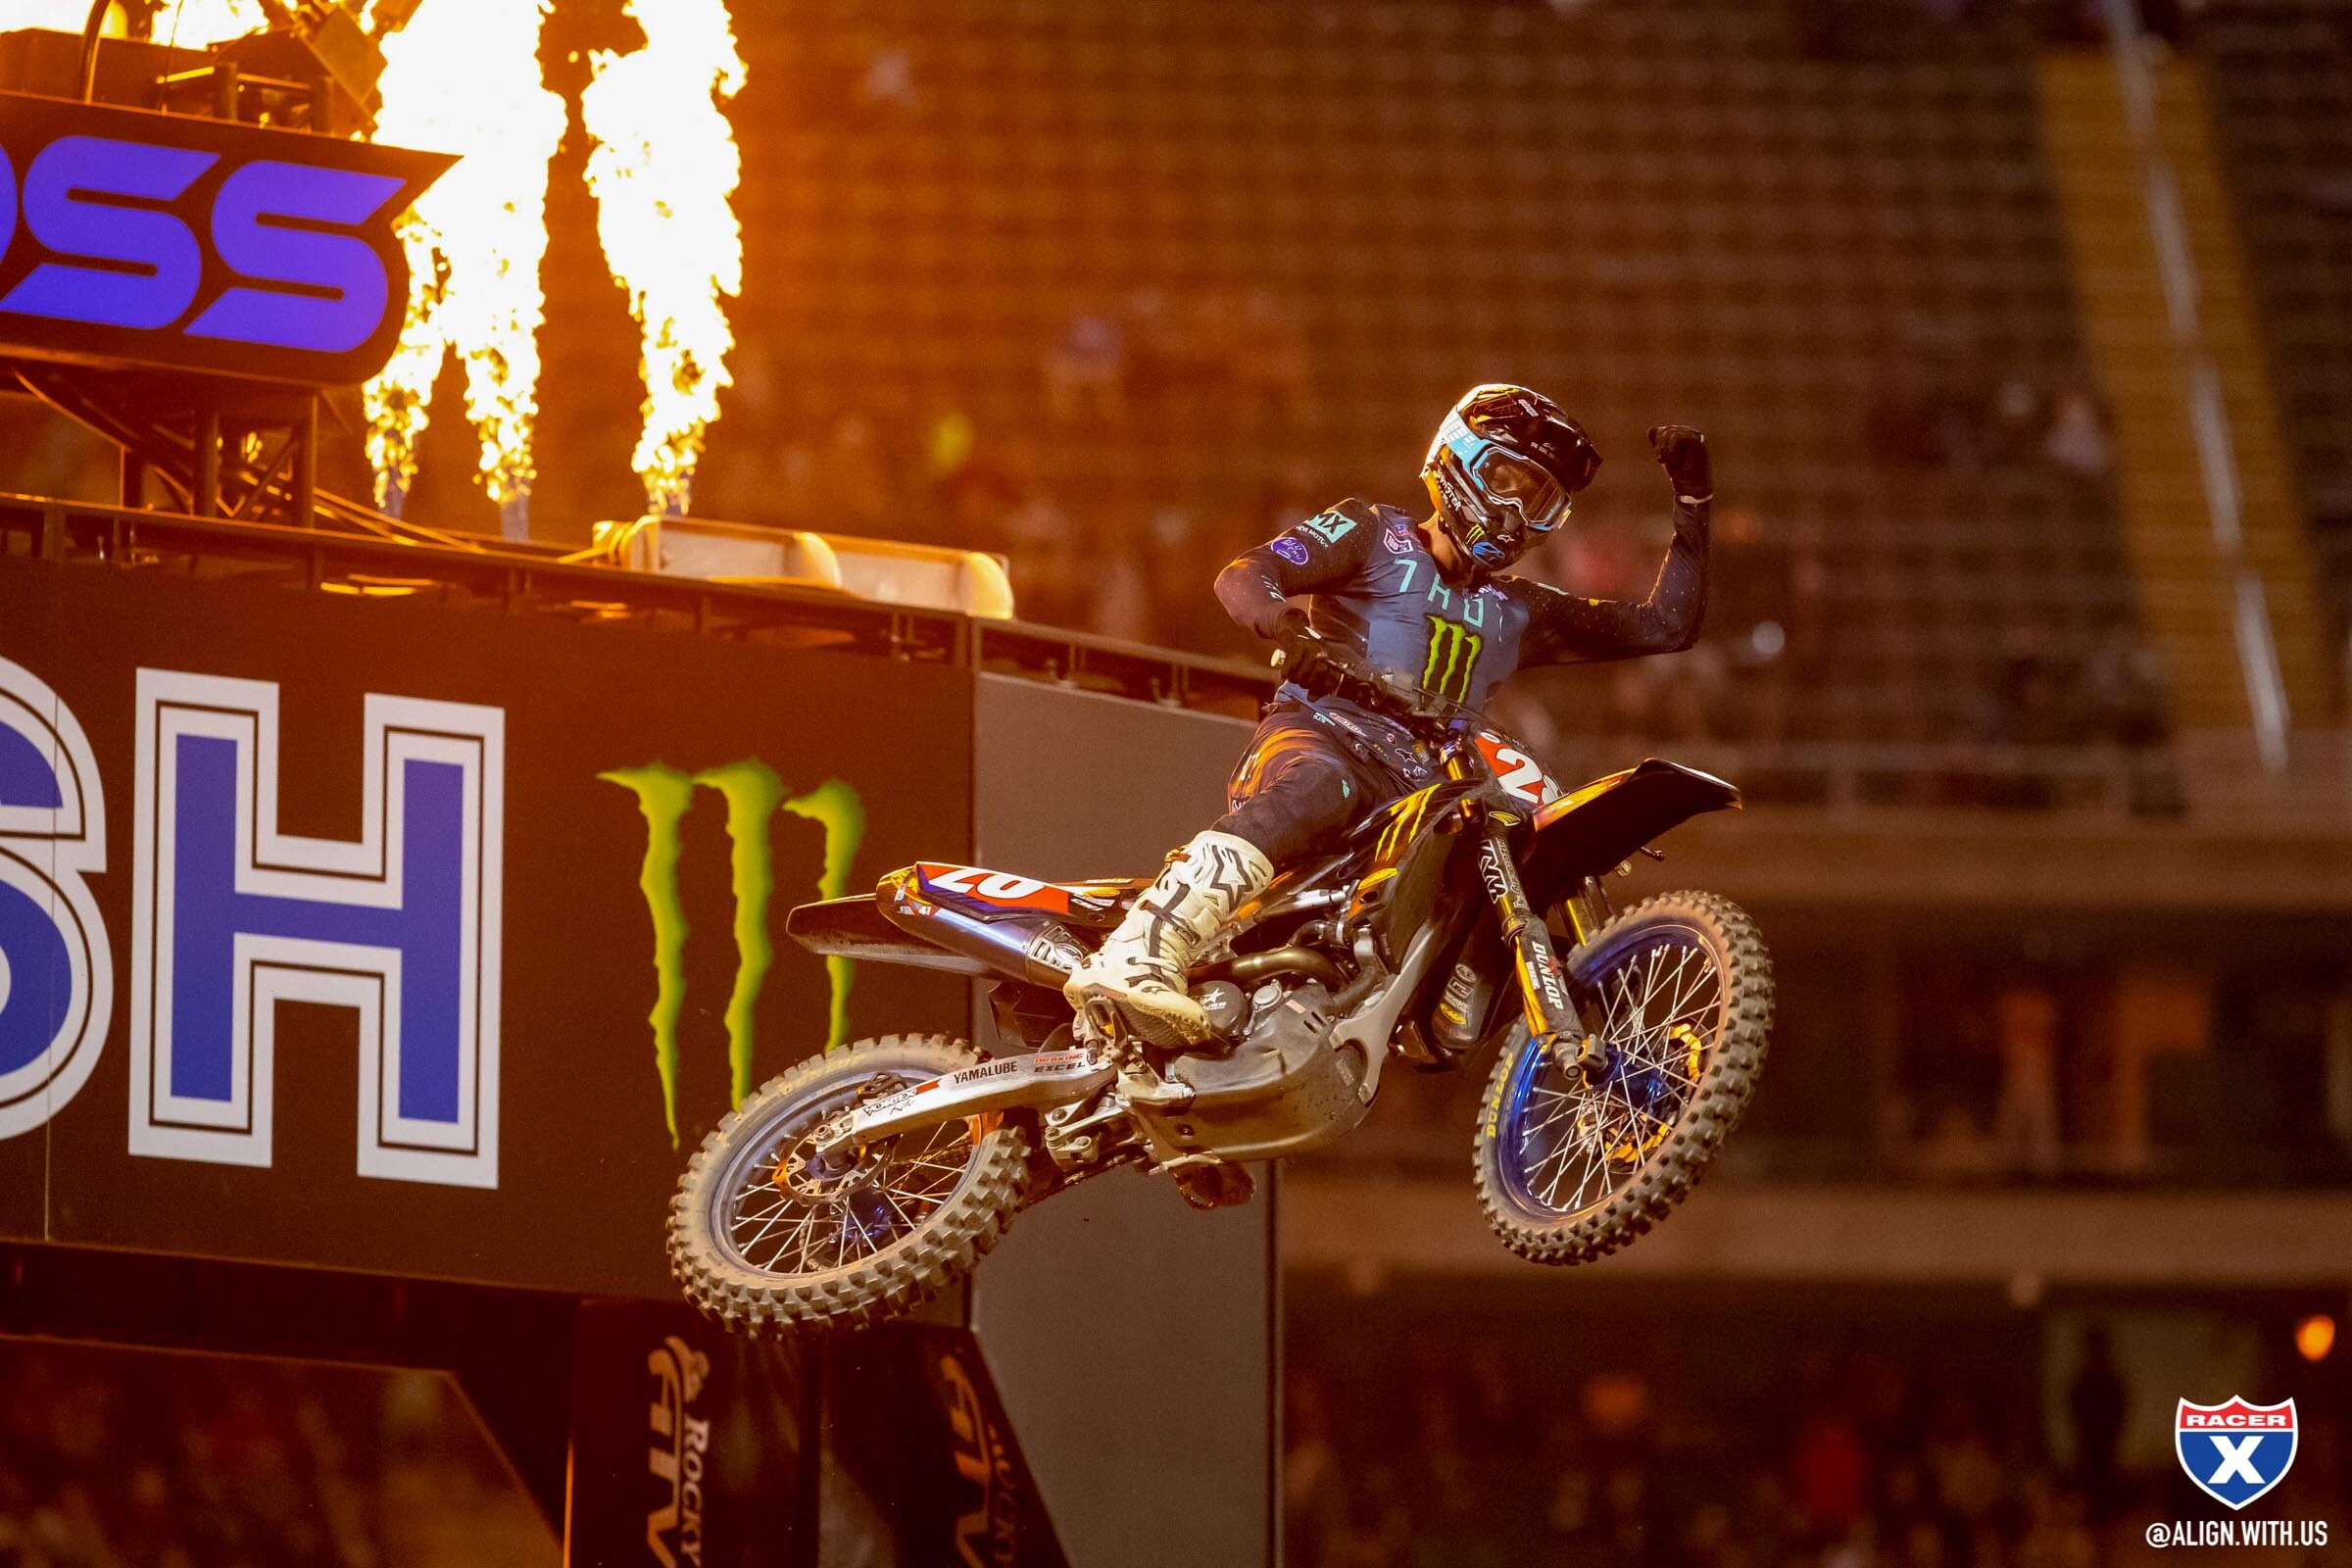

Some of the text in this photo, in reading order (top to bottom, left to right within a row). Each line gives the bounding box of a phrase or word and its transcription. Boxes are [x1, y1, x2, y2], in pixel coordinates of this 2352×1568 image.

[0, 135, 407, 353] SS
[1531, 940, 1564, 1010] DUNLOP
[954, 1061, 1018, 1084] YAMALUBE
[1034, 1061, 1086, 1073] EXCEL
[1486, 1052, 1514, 1138] DUNLOP
[682, 1412, 710, 1567] ROCKY
